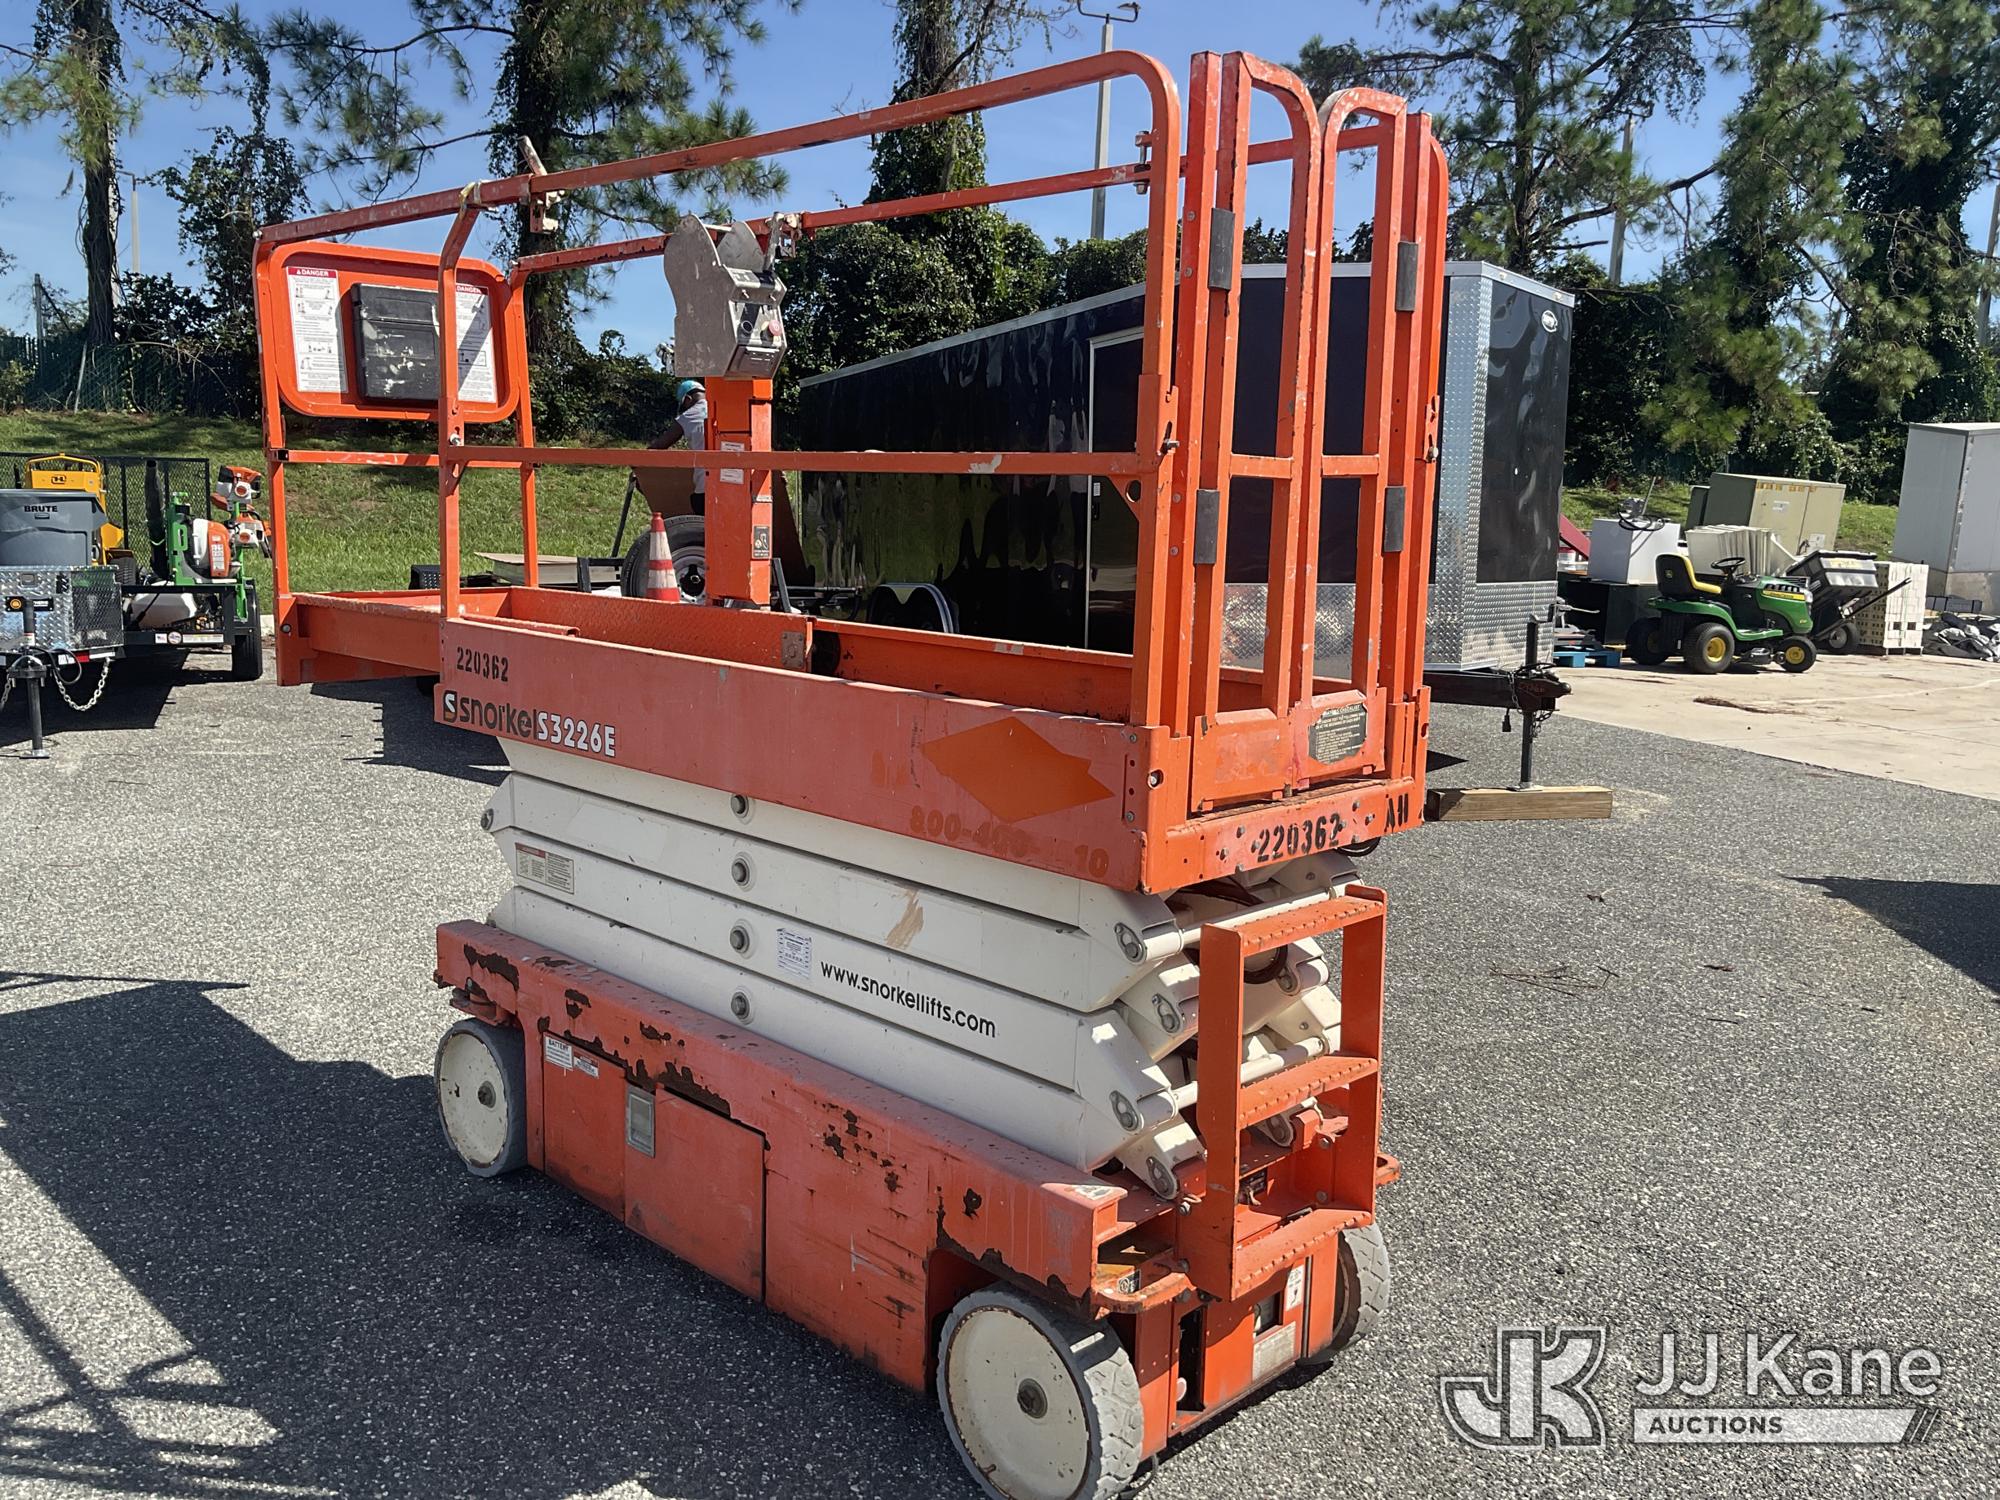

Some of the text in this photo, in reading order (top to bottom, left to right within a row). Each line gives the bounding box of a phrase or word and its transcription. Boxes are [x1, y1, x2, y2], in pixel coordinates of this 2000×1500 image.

[301, 269, 329, 277] DANGER
[456, 285, 482, 295] DANGER
[24, 505, 58, 513] BRUTE
[456, 646, 509, 682] 220362
[459, 696, 538, 739] snorkel
[537, 710, 616, 757] S3226E
[1256, 811, 1344, 863] 220362
[820, 961, 996, 1038] www.snorkellifts.com
[548, 1038, 569, 1052] BATTERY
